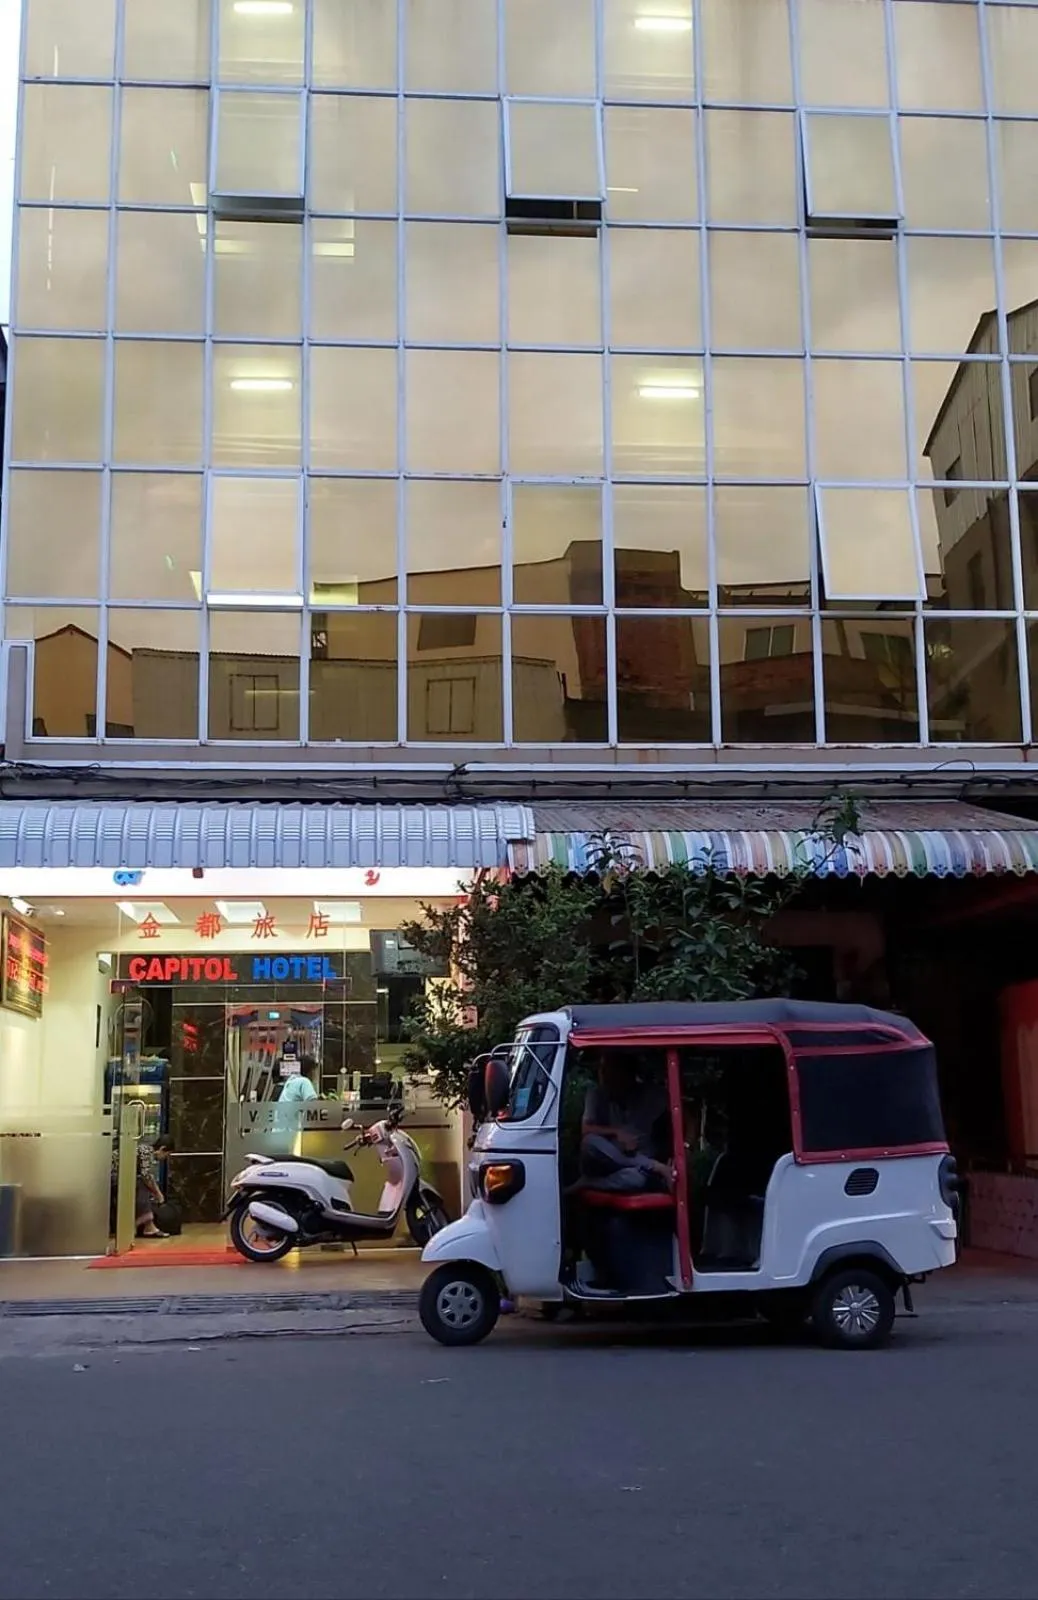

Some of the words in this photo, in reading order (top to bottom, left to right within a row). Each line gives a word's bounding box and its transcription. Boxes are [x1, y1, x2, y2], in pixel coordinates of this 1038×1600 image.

[138, 911, 331, 939] 金都旅店
[129, 956, 239, 981] CAPITOL
[253, 956, 337, 980] HOTEL
[248, 1108, 329, 1123] WELME
